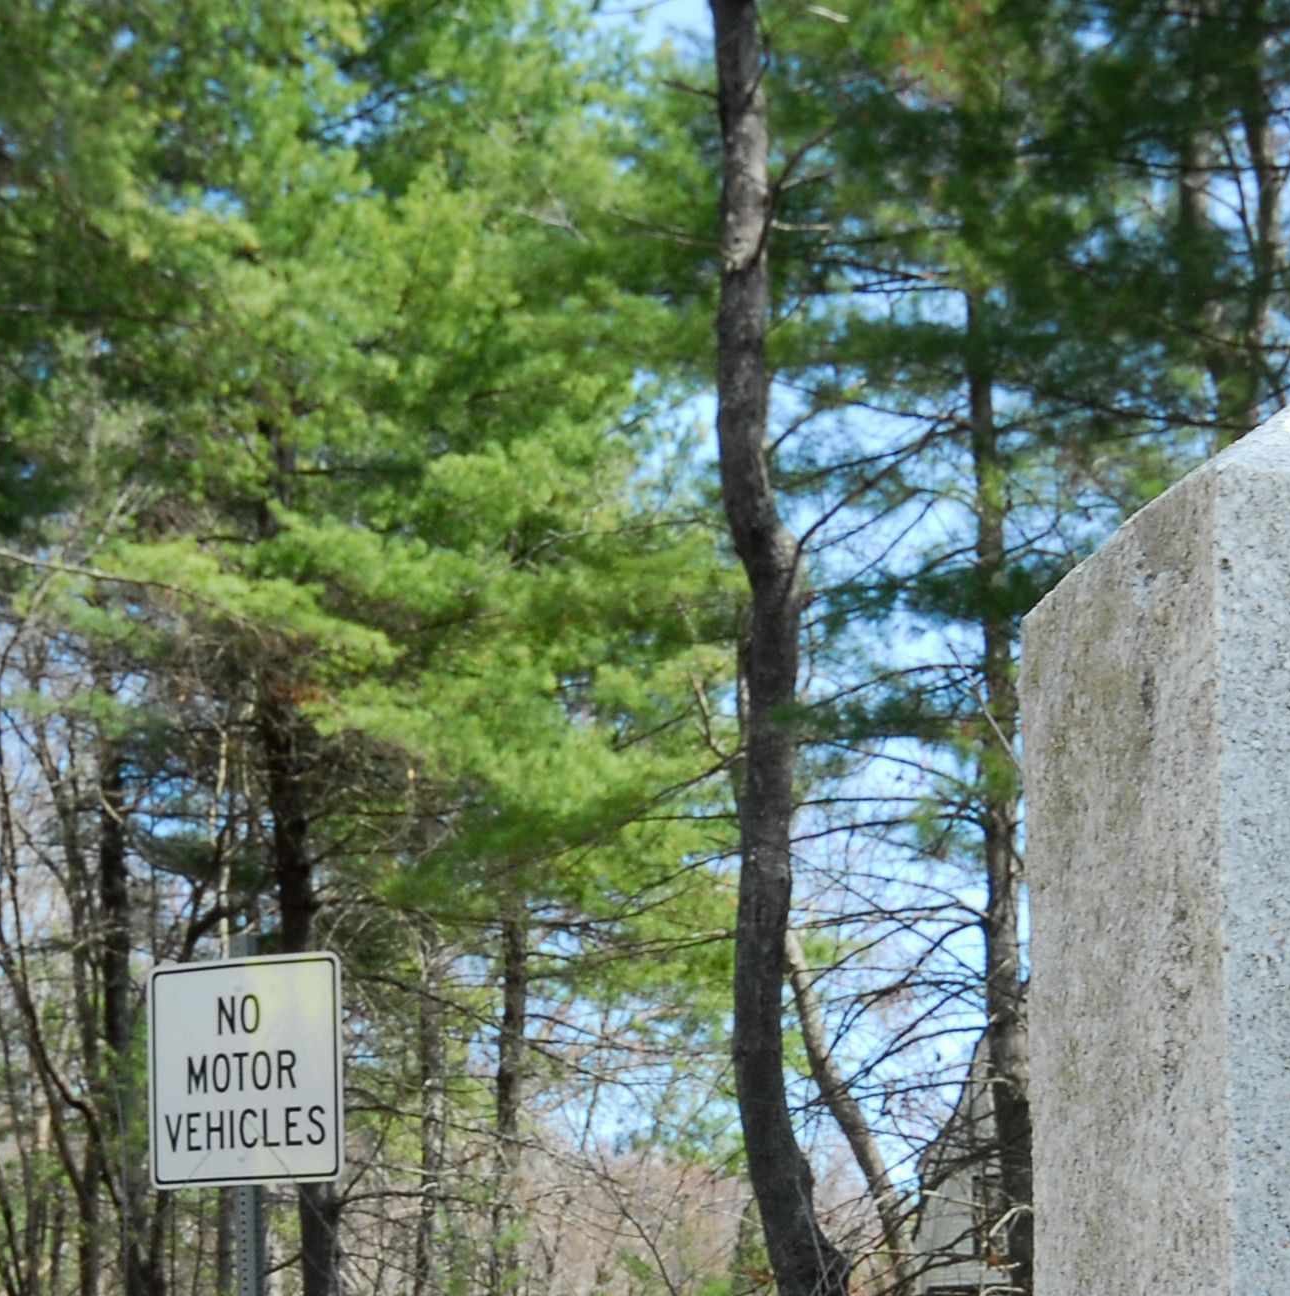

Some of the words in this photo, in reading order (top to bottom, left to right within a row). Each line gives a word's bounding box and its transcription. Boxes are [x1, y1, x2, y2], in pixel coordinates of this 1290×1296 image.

[217, 993, 260, 1036] NO
[186, 1049, 297, 1095] MOTOR
[165, 1105, 326, 1153] VEHICLES
